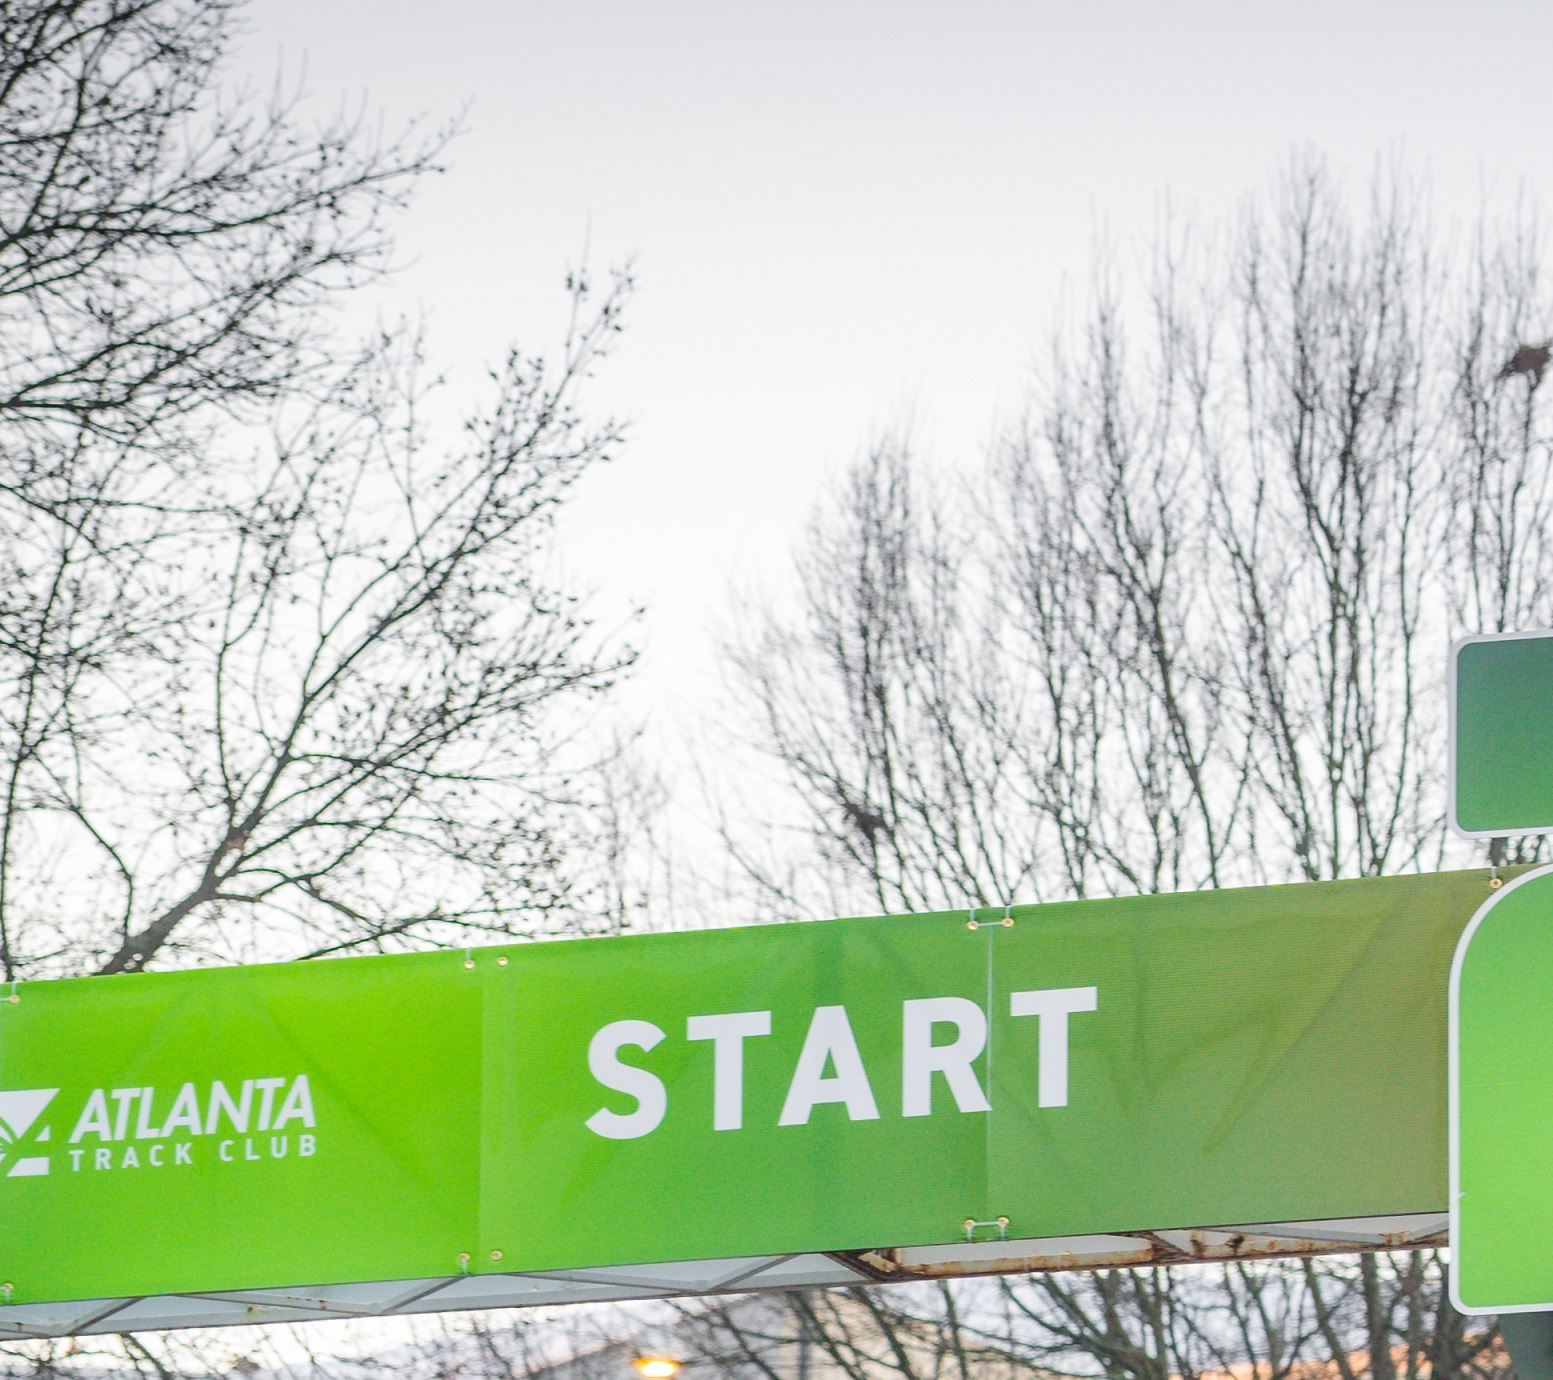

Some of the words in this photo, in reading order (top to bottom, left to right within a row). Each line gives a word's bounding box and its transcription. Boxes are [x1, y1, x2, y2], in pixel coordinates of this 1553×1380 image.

[585, 986, 1098, 1139] START
[69, 1075, 316, 1143] ATLANTA
[70, 1143, 191, 1171] TRACK
[220, 1135, 315, 1161] CLUB
